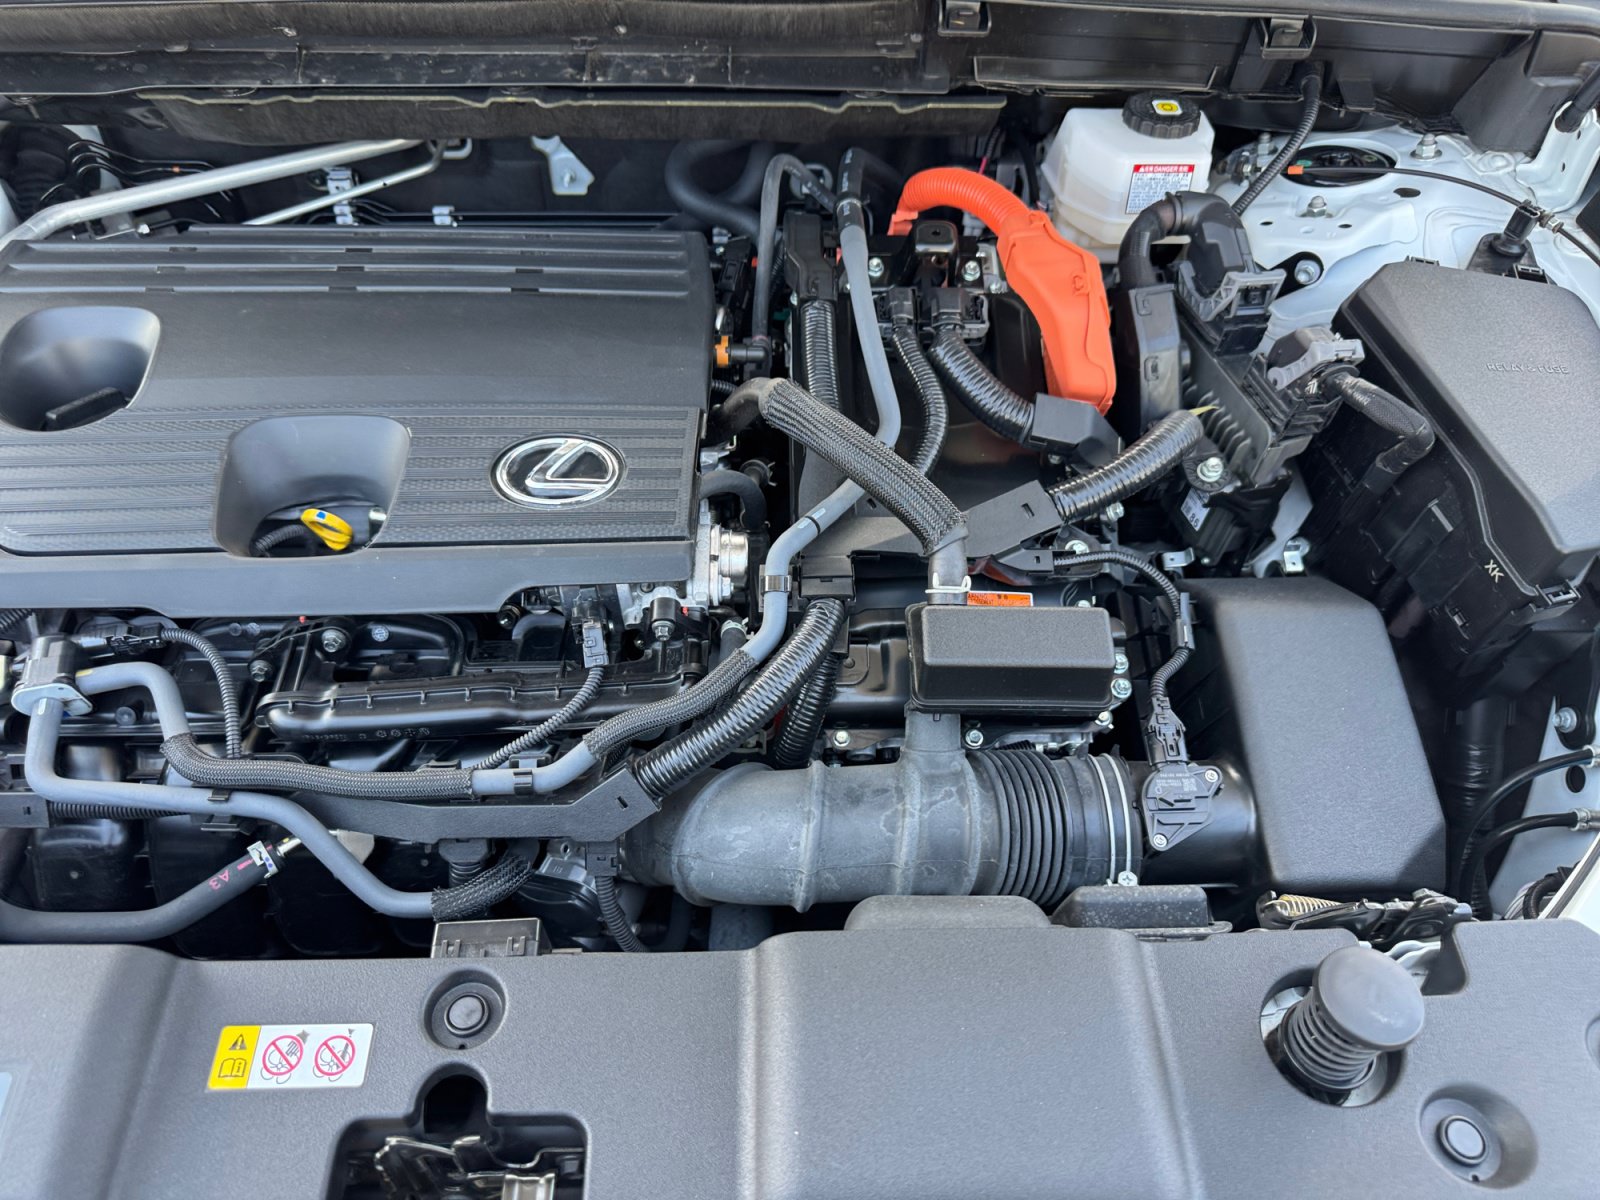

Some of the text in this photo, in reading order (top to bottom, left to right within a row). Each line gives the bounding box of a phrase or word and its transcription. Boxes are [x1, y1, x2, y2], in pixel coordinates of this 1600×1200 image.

[1153, 165, 1178, 173] DANGER
[1486, 363, 1569, 374] RELAY & FUSE
[1484, 559, 1505, 584] XK
[208, 869, 230, 890] A3
